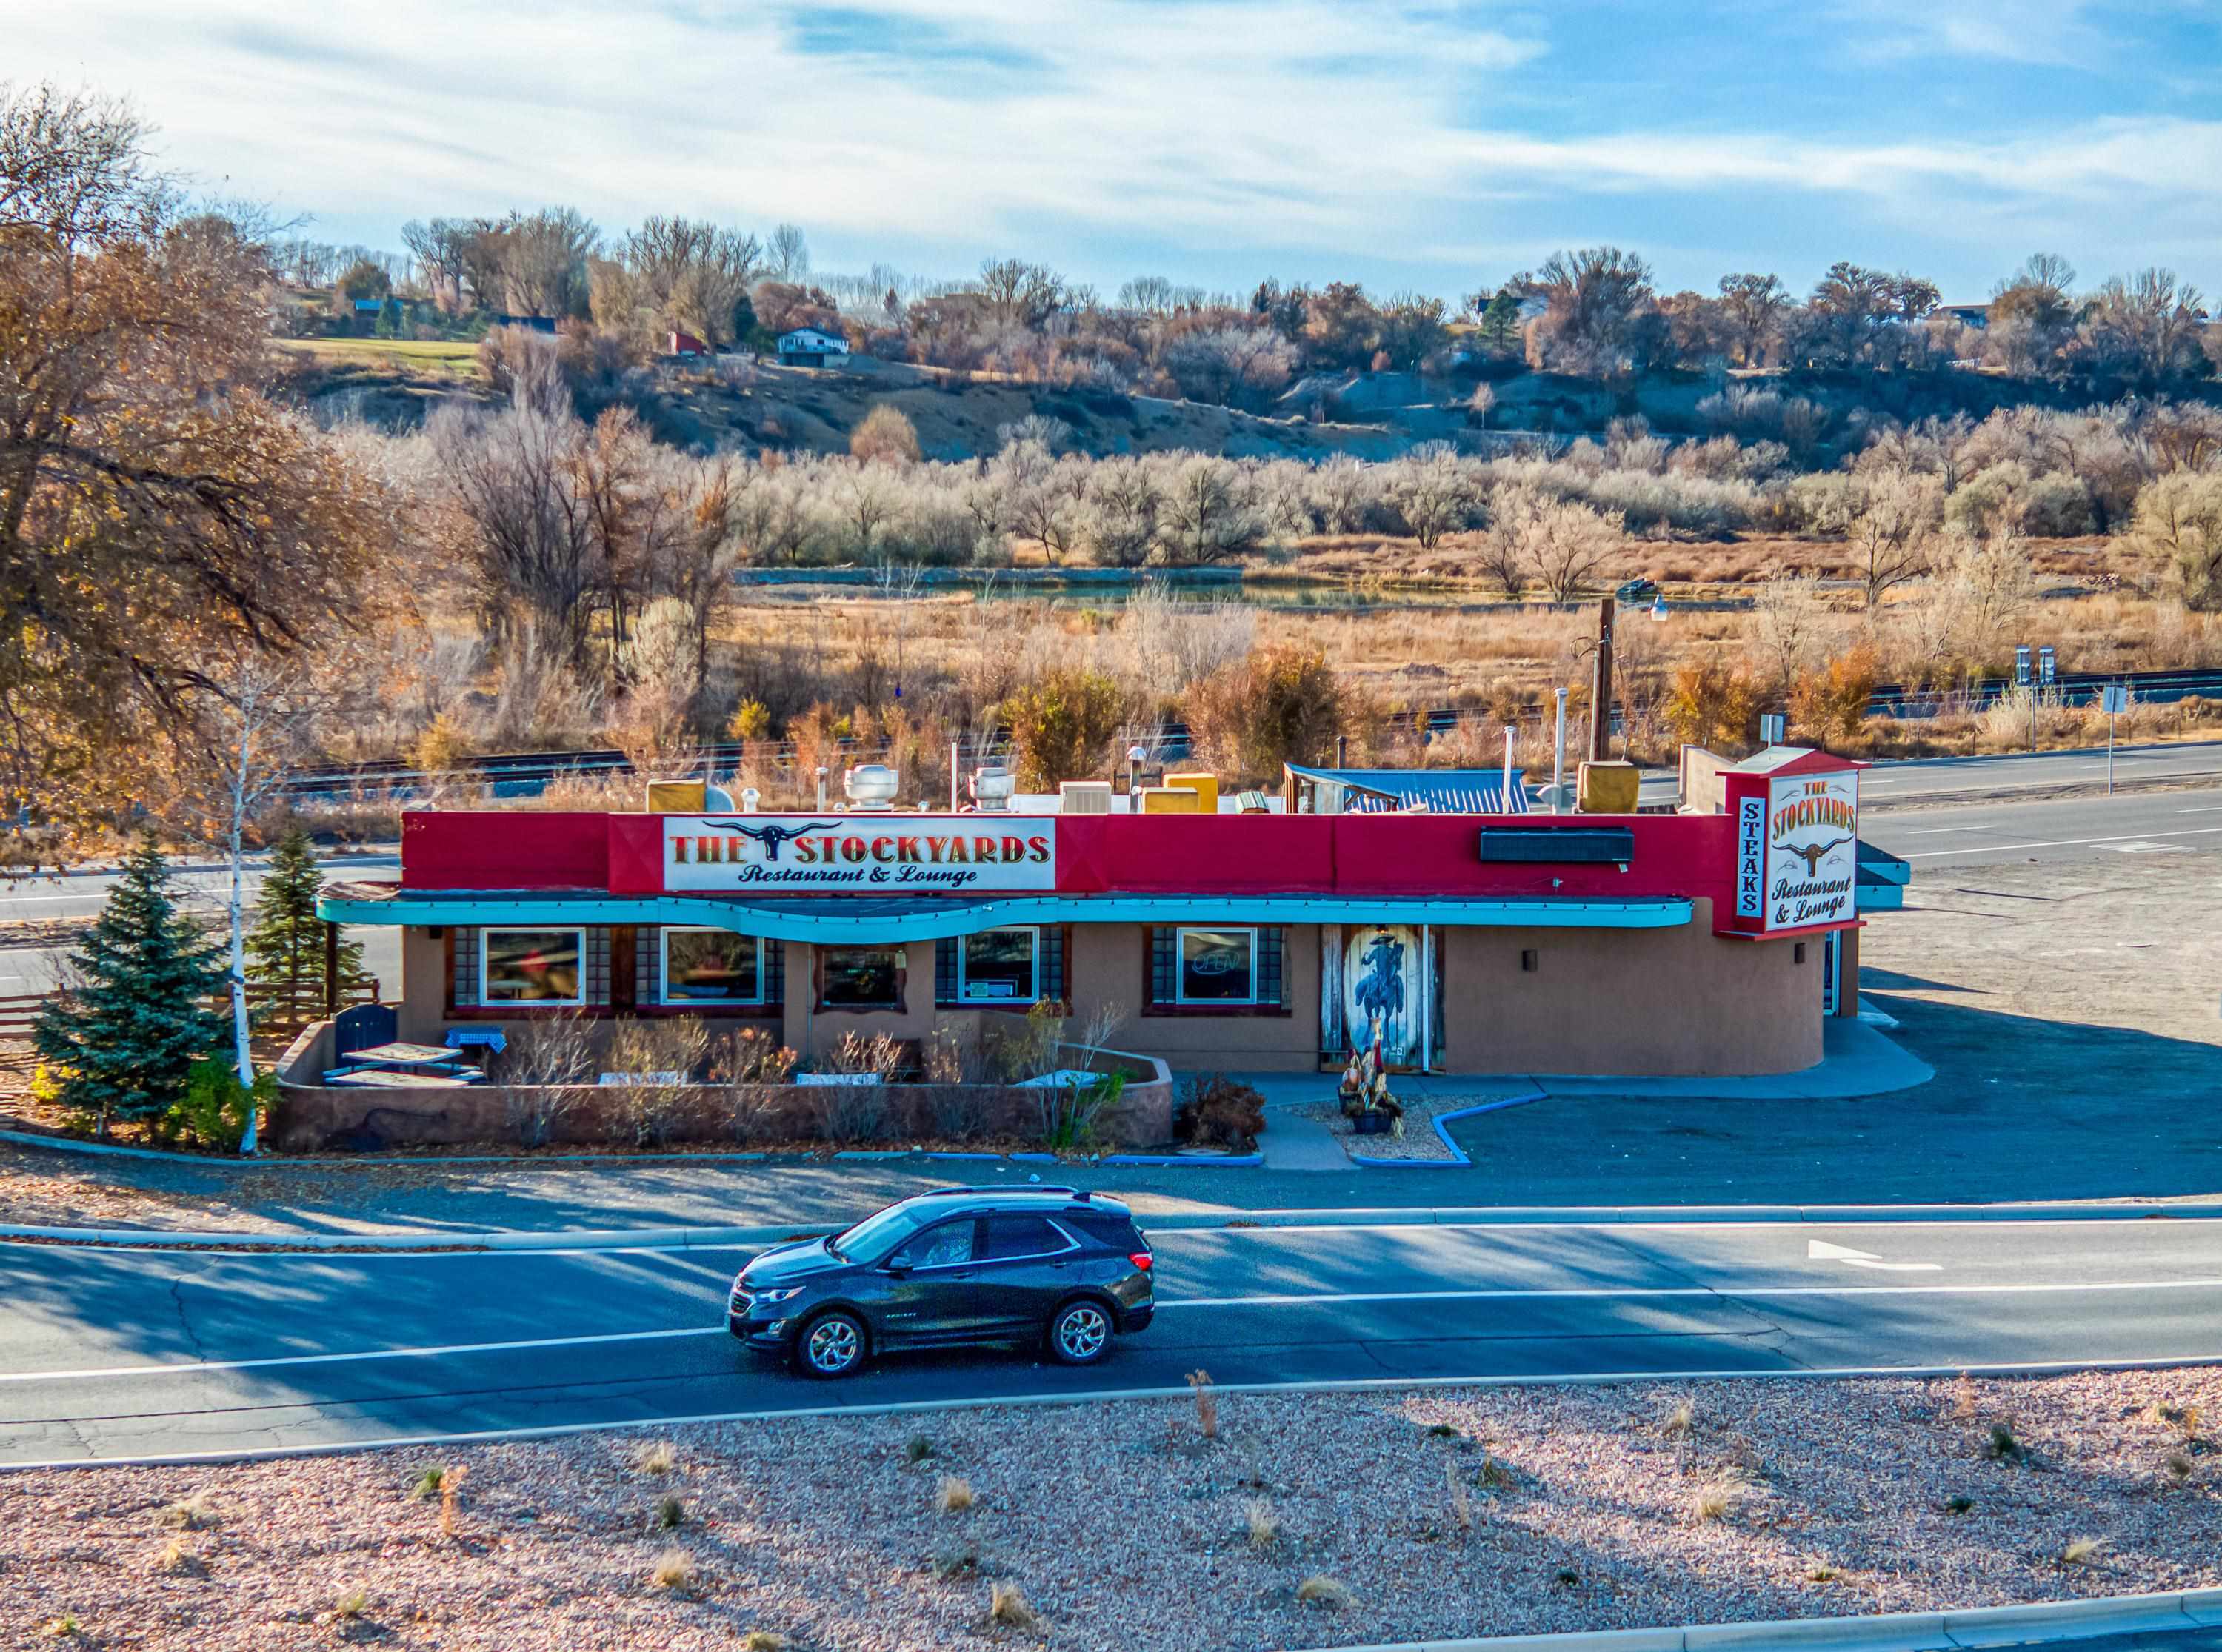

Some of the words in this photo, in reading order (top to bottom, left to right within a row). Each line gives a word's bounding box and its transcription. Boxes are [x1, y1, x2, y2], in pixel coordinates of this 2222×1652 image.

[1803, 781, 1828, 795] THE
[1772, 797, 1855, 841] STOCKYARDS
[669, 836, 747, 864] THE
[794, 835, 1052, 864] STOCKYARDS
[1741, 803, 1761, 912] STEAKS
[738, 864, 865, 883] Restaurant
[868, 865, 890, 883] &
[894, 865, 978, 887] Lounge
[1772, 876, 1852, 900] Restaurant
[1775, 904, 1790, 924] &
[1792, 894, 1846, 922] Lounge
[1194, 954, 1236, 970] OPEN
